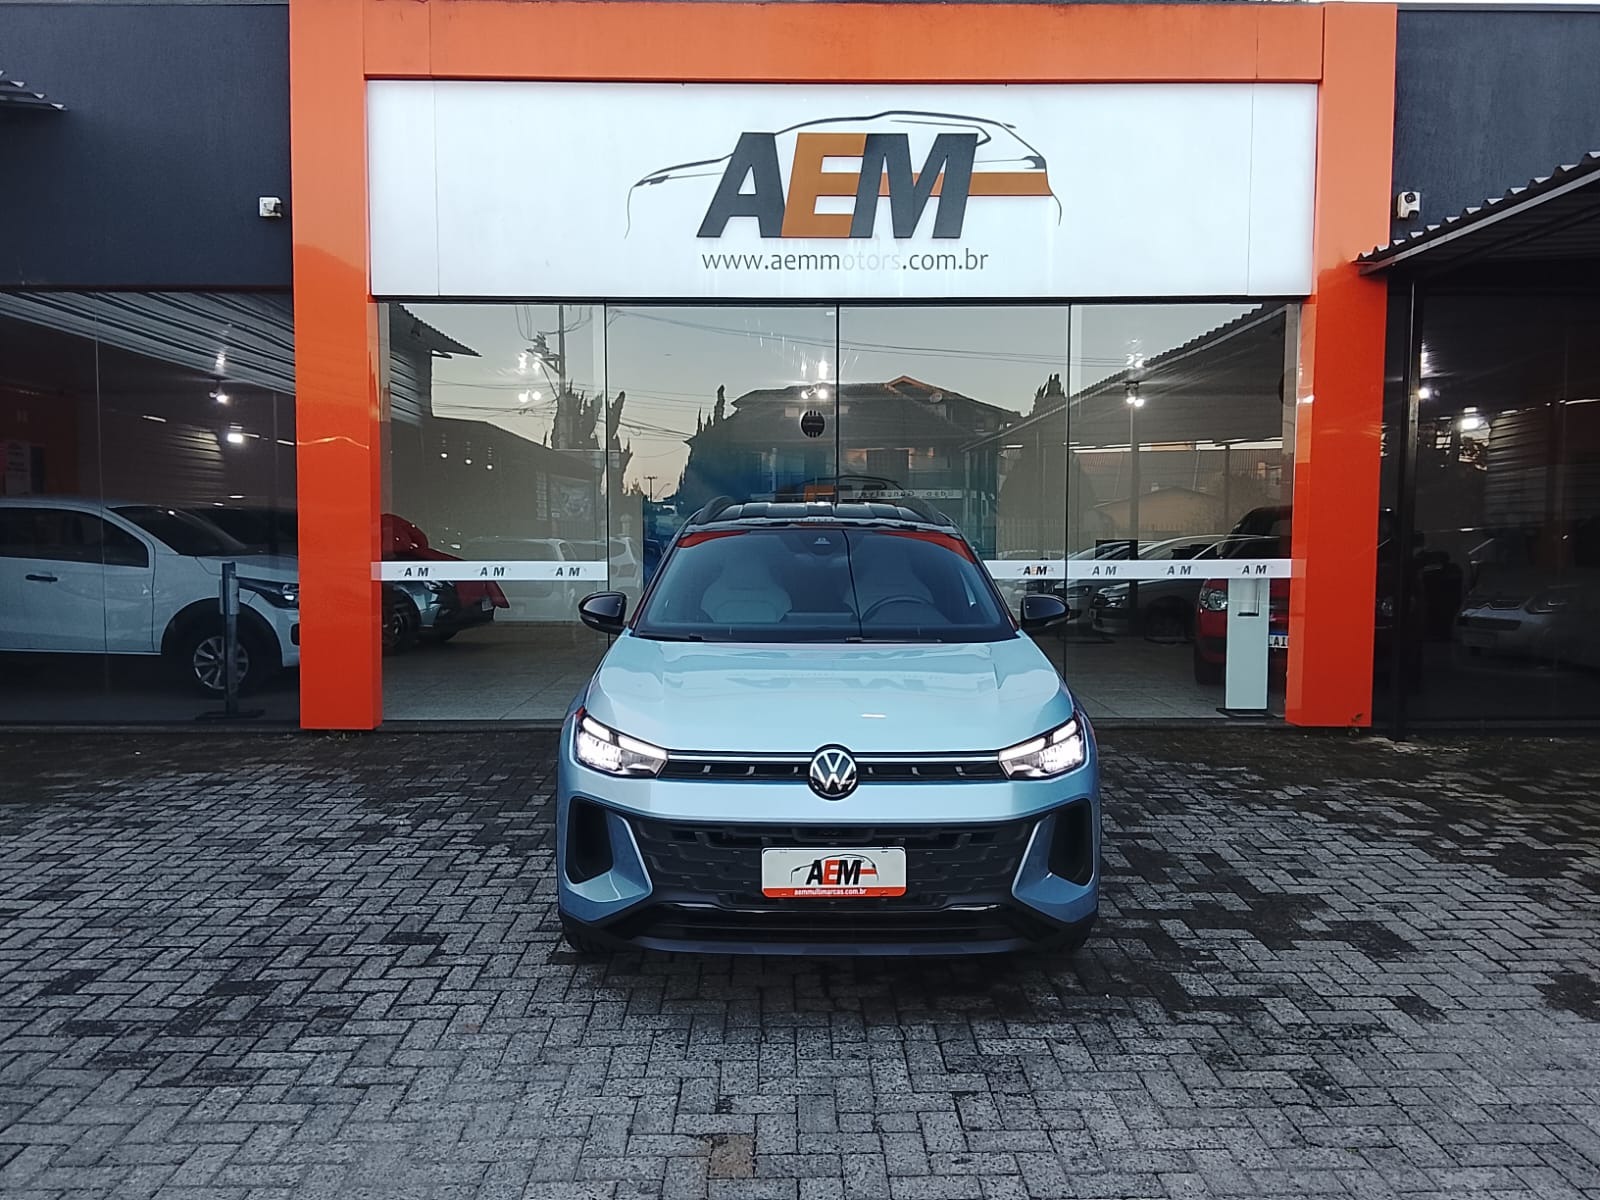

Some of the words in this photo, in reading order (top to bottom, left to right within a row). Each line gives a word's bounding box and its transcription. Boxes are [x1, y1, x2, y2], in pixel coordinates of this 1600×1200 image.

[696, 132, 979, 239] AEM
[701, 248, 989, 271] www.aemmotors.com.br
[805, 859, 863, 886] AEM
